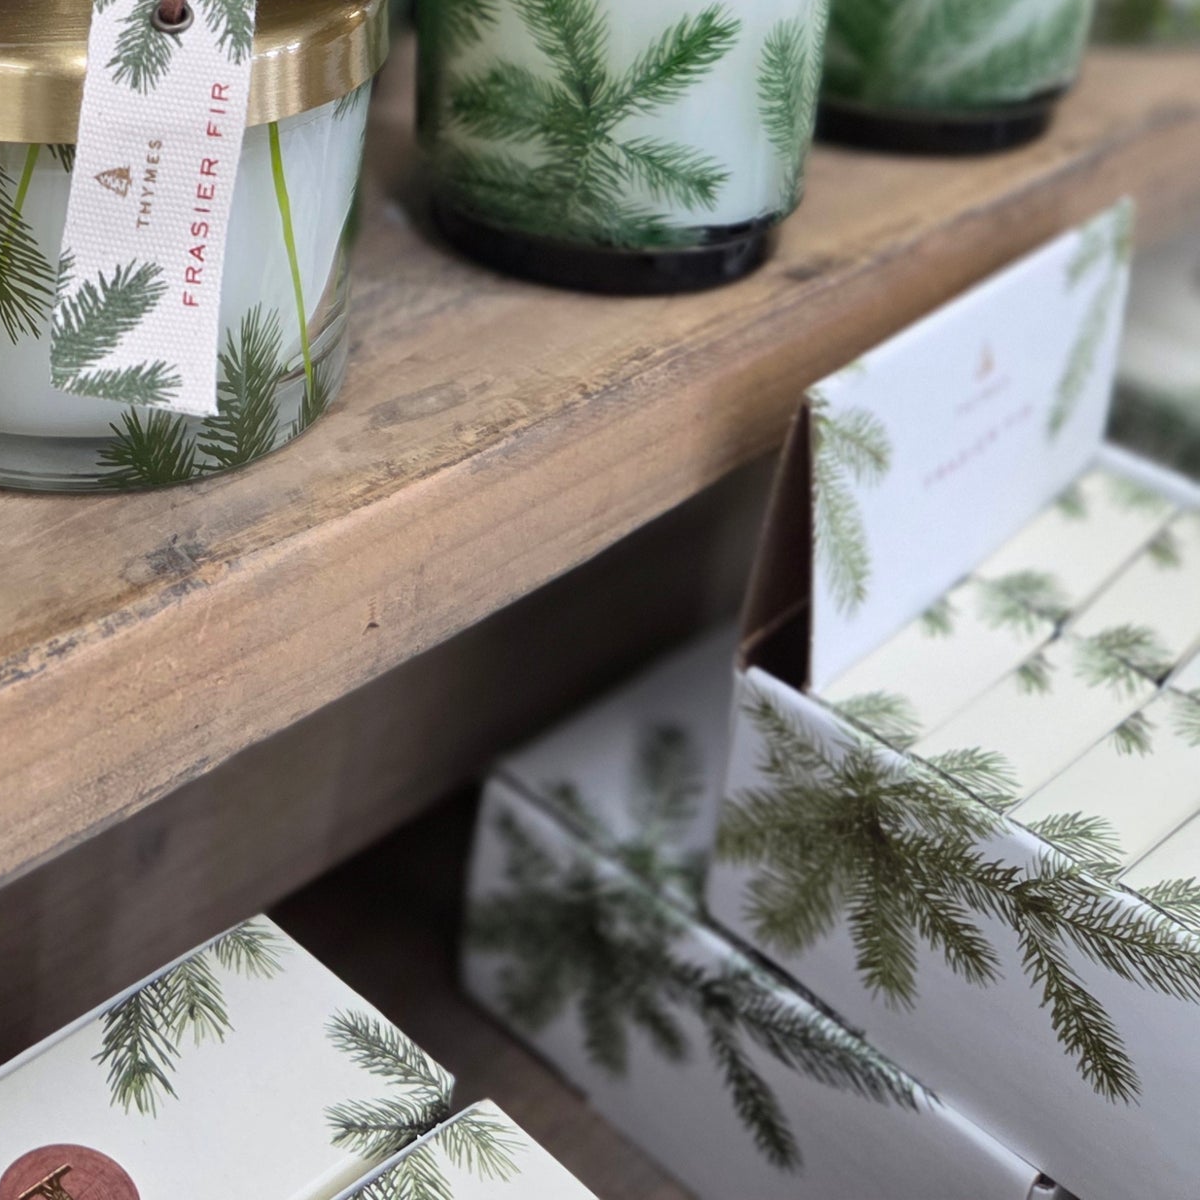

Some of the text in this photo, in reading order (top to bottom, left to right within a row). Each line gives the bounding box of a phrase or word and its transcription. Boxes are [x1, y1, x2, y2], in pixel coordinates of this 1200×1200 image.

[136, 139, 163, 229] THYMES
[183, 82, 230, 307] FRASIER FIR
